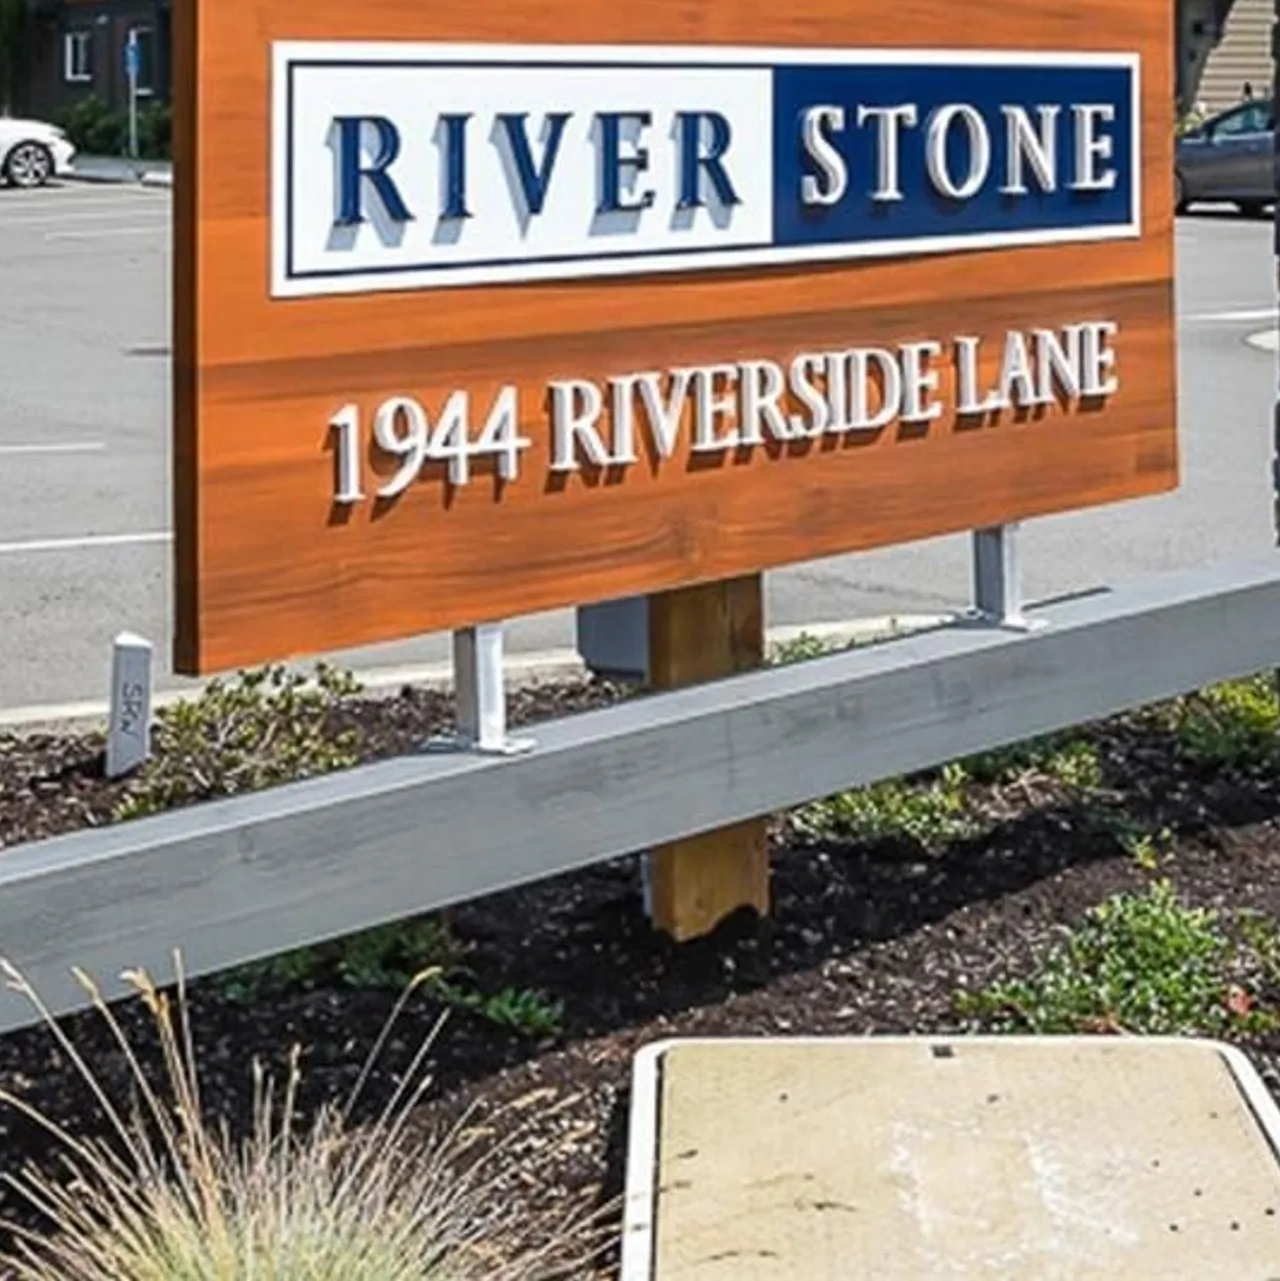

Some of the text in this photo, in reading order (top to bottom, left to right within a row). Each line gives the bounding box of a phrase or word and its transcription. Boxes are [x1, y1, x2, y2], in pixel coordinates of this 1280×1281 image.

[330, 102, 1118, 227] RIVER STONE
[326, 320, 1118, 504] 1944 RIVERSIDE LANE
